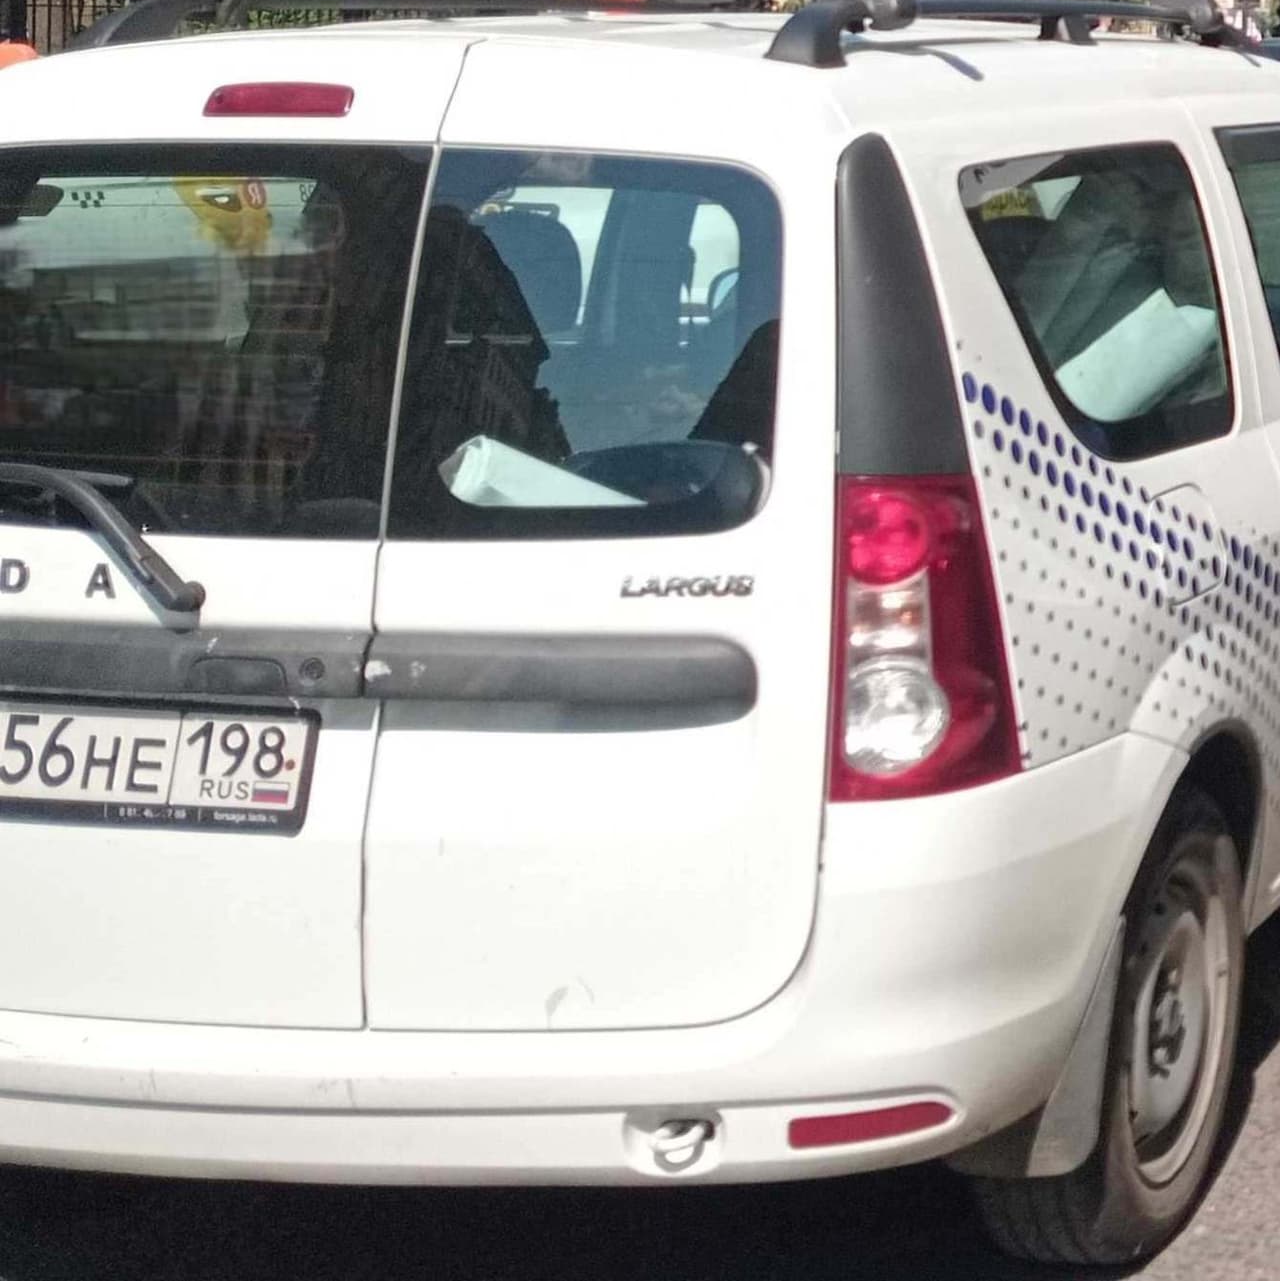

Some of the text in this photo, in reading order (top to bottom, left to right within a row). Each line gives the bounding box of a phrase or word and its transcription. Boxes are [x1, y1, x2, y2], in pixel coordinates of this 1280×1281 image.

[619, 574, 755, 598] LARGUS
[187, 720, 286, 779] 198
[199, 778, 250, 801] RUS
